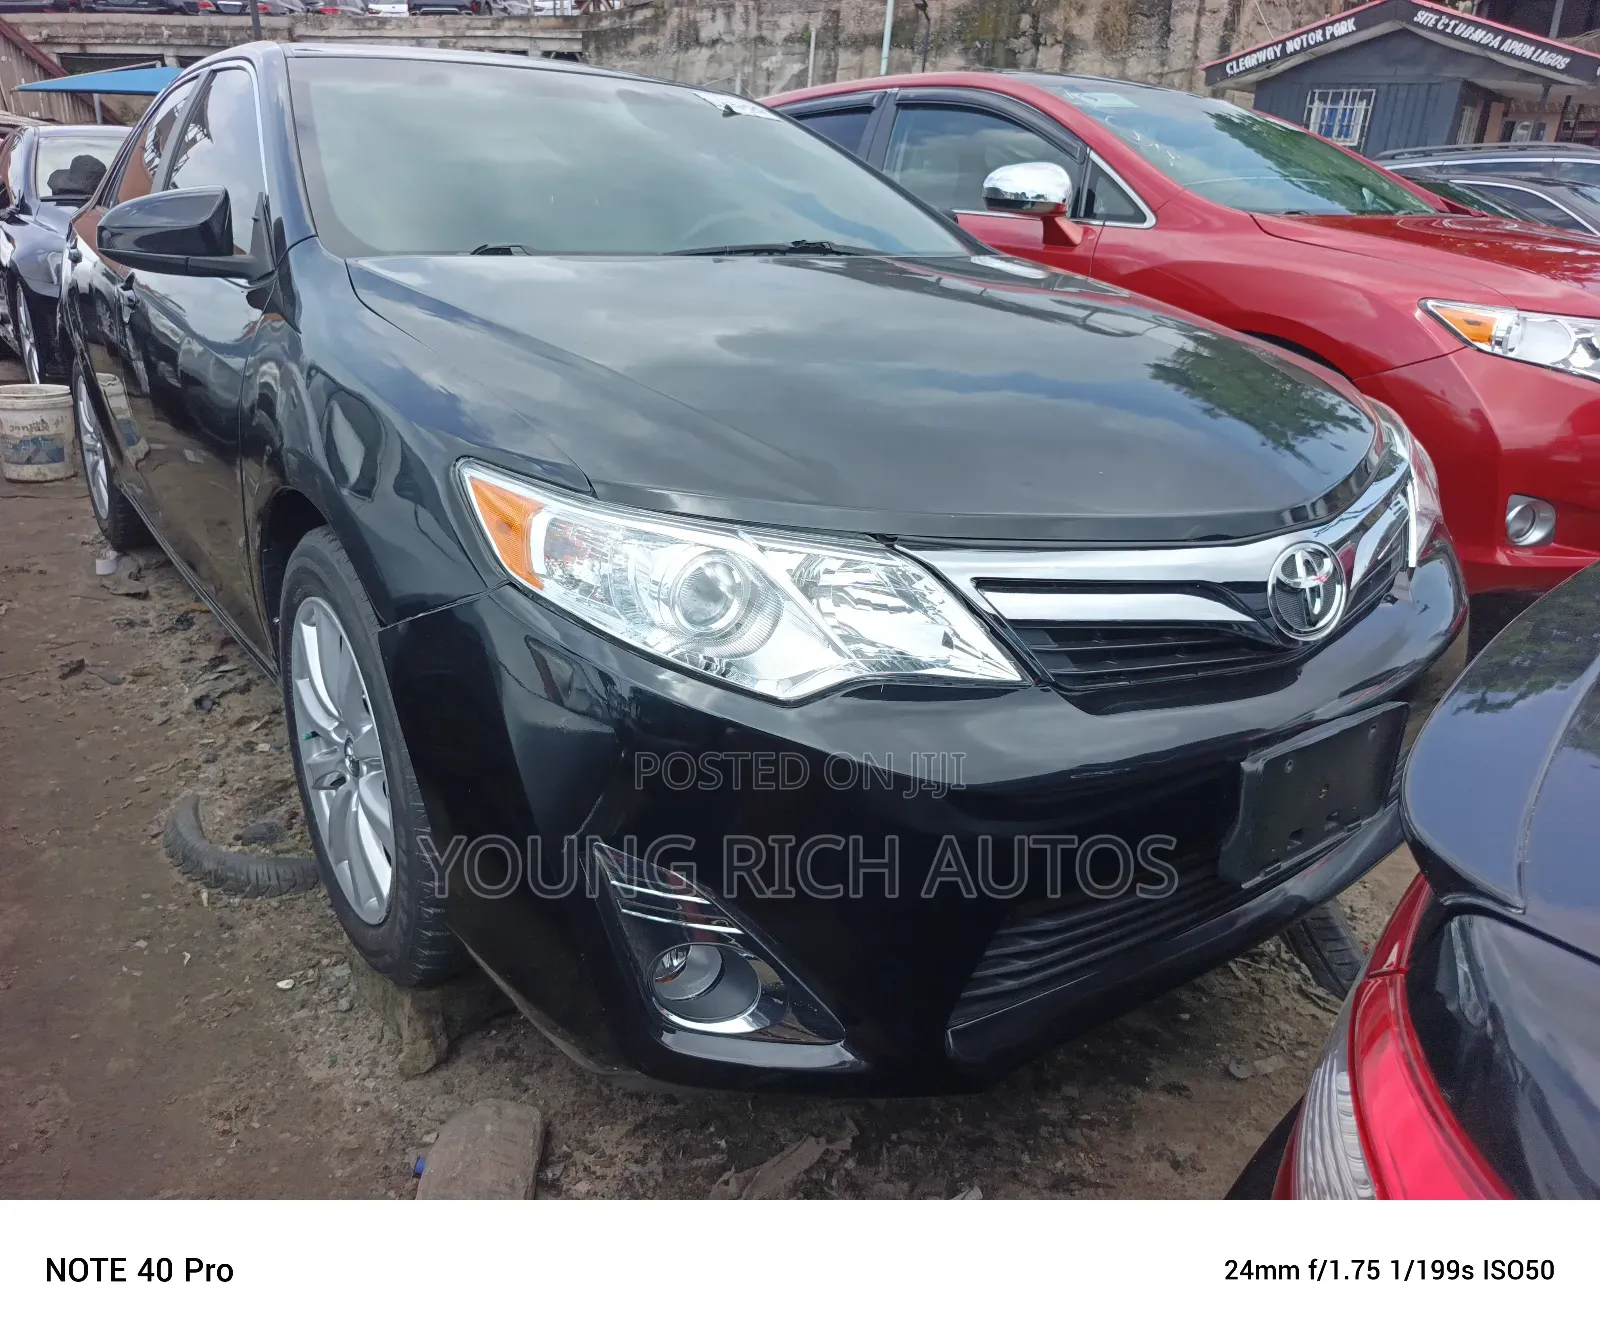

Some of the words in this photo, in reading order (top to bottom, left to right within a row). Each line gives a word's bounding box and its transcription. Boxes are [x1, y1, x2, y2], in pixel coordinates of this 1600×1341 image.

[1225, 43, 1283, 76] CLEARWAY
[1325, 17, 1357, 41] PARK
[1413, 10, 1438, 28] SITE
[1500, 38, 1536, 59] APAPA
[1530, 49, 1571, 70] LAGOS
